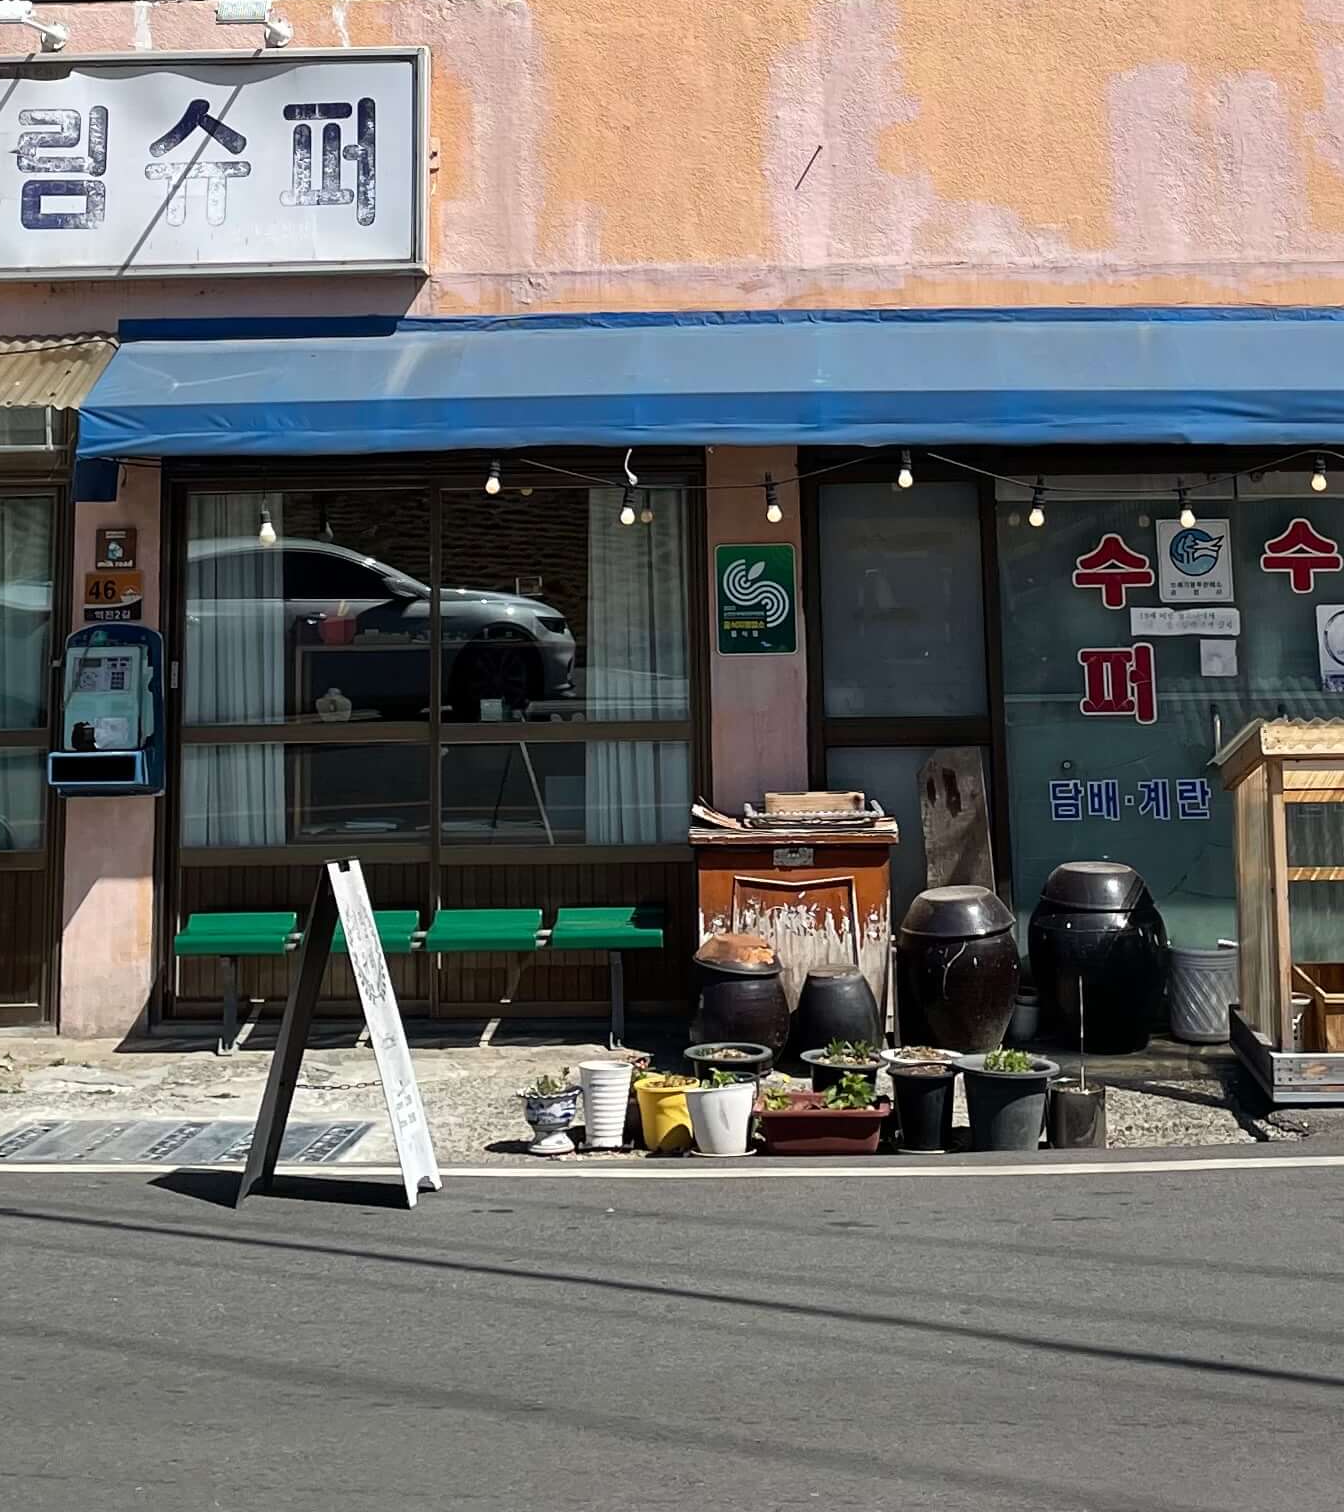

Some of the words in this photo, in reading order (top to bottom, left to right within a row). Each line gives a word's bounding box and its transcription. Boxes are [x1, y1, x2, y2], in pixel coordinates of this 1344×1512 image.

[115, 559, 134, 568] road
[88, 579, 117, 601] 46
[1049, 776, 1212, 822] 담배·계란
